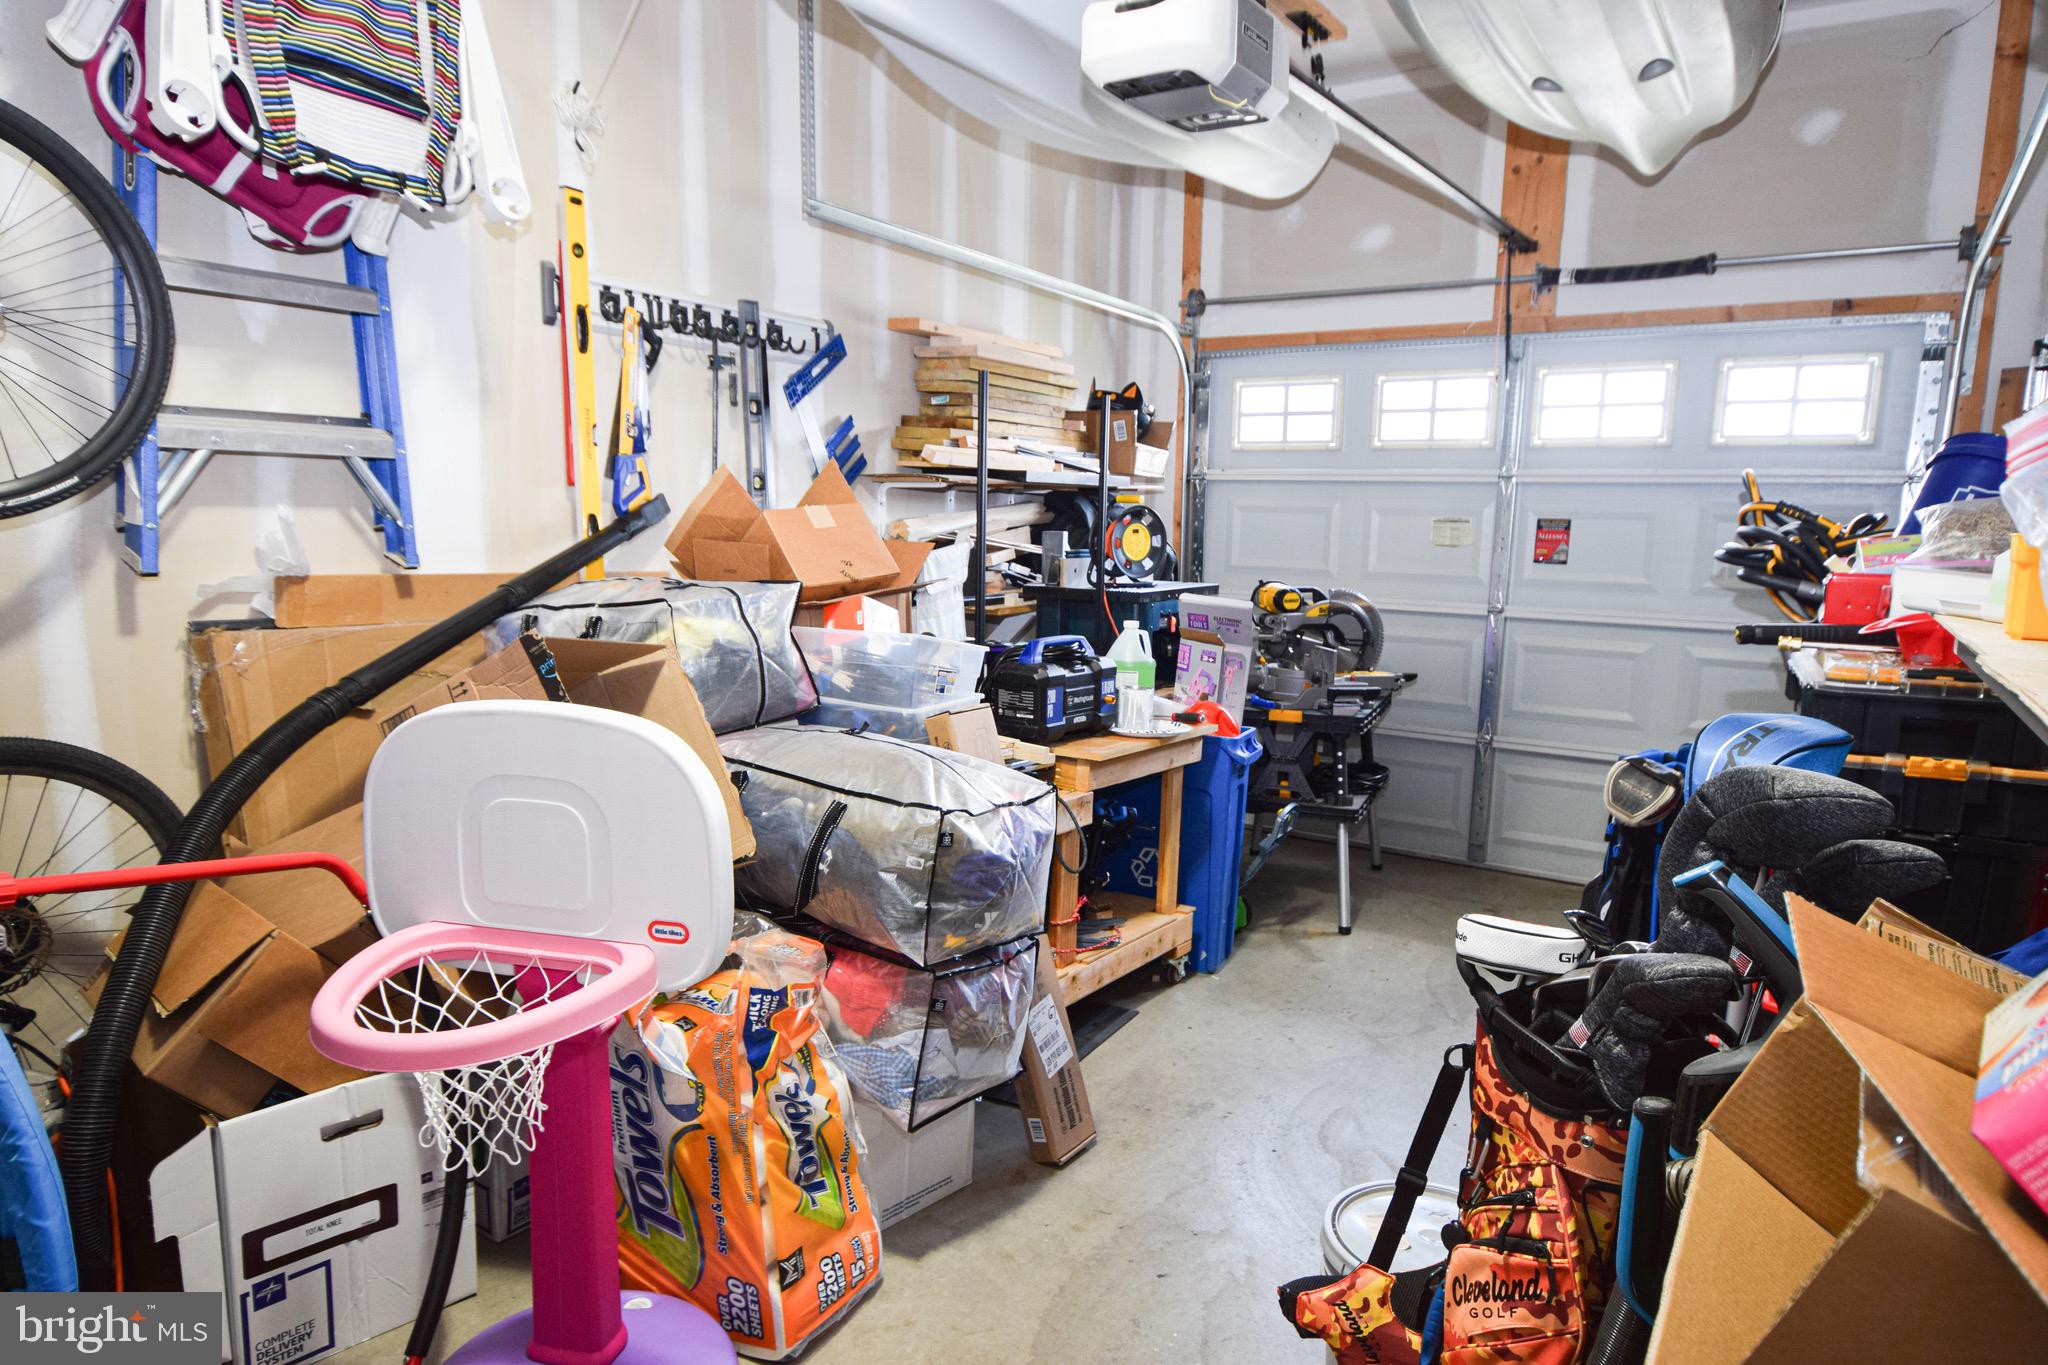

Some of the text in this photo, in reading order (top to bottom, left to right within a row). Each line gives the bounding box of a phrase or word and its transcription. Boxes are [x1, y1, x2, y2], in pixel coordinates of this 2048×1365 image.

[1721, 724, 1780, 770] TRA
[654, 927, 668, 935] little
[1558, 952, 1581, 964] GH
[610, 1046, 686, 1241] Towels
[774, 1081, 830, 1209] Towels
[706, 1134, 729, 1255] Strong & Absorbent
[843, 1175, 858, 1213] Strong
[304, 1224, 325, 1237] TOTAL
[819, 1256, 839, 1305] 2200
[851, 1261, 866, 1288] 15
[1451, 1266, 1544, 1307] Cleveland
[718, 1295, 732, 1330] OVER
[727, 1278, 749, 1335] 2200
[745, 1284, 763, 1338] SHEETS
[1469, 1306, 1519, 1319] GOLF
[254, 1318, 317, 1351] COMPLETE
[256, 1329, 314, 1361] DELIVERY
